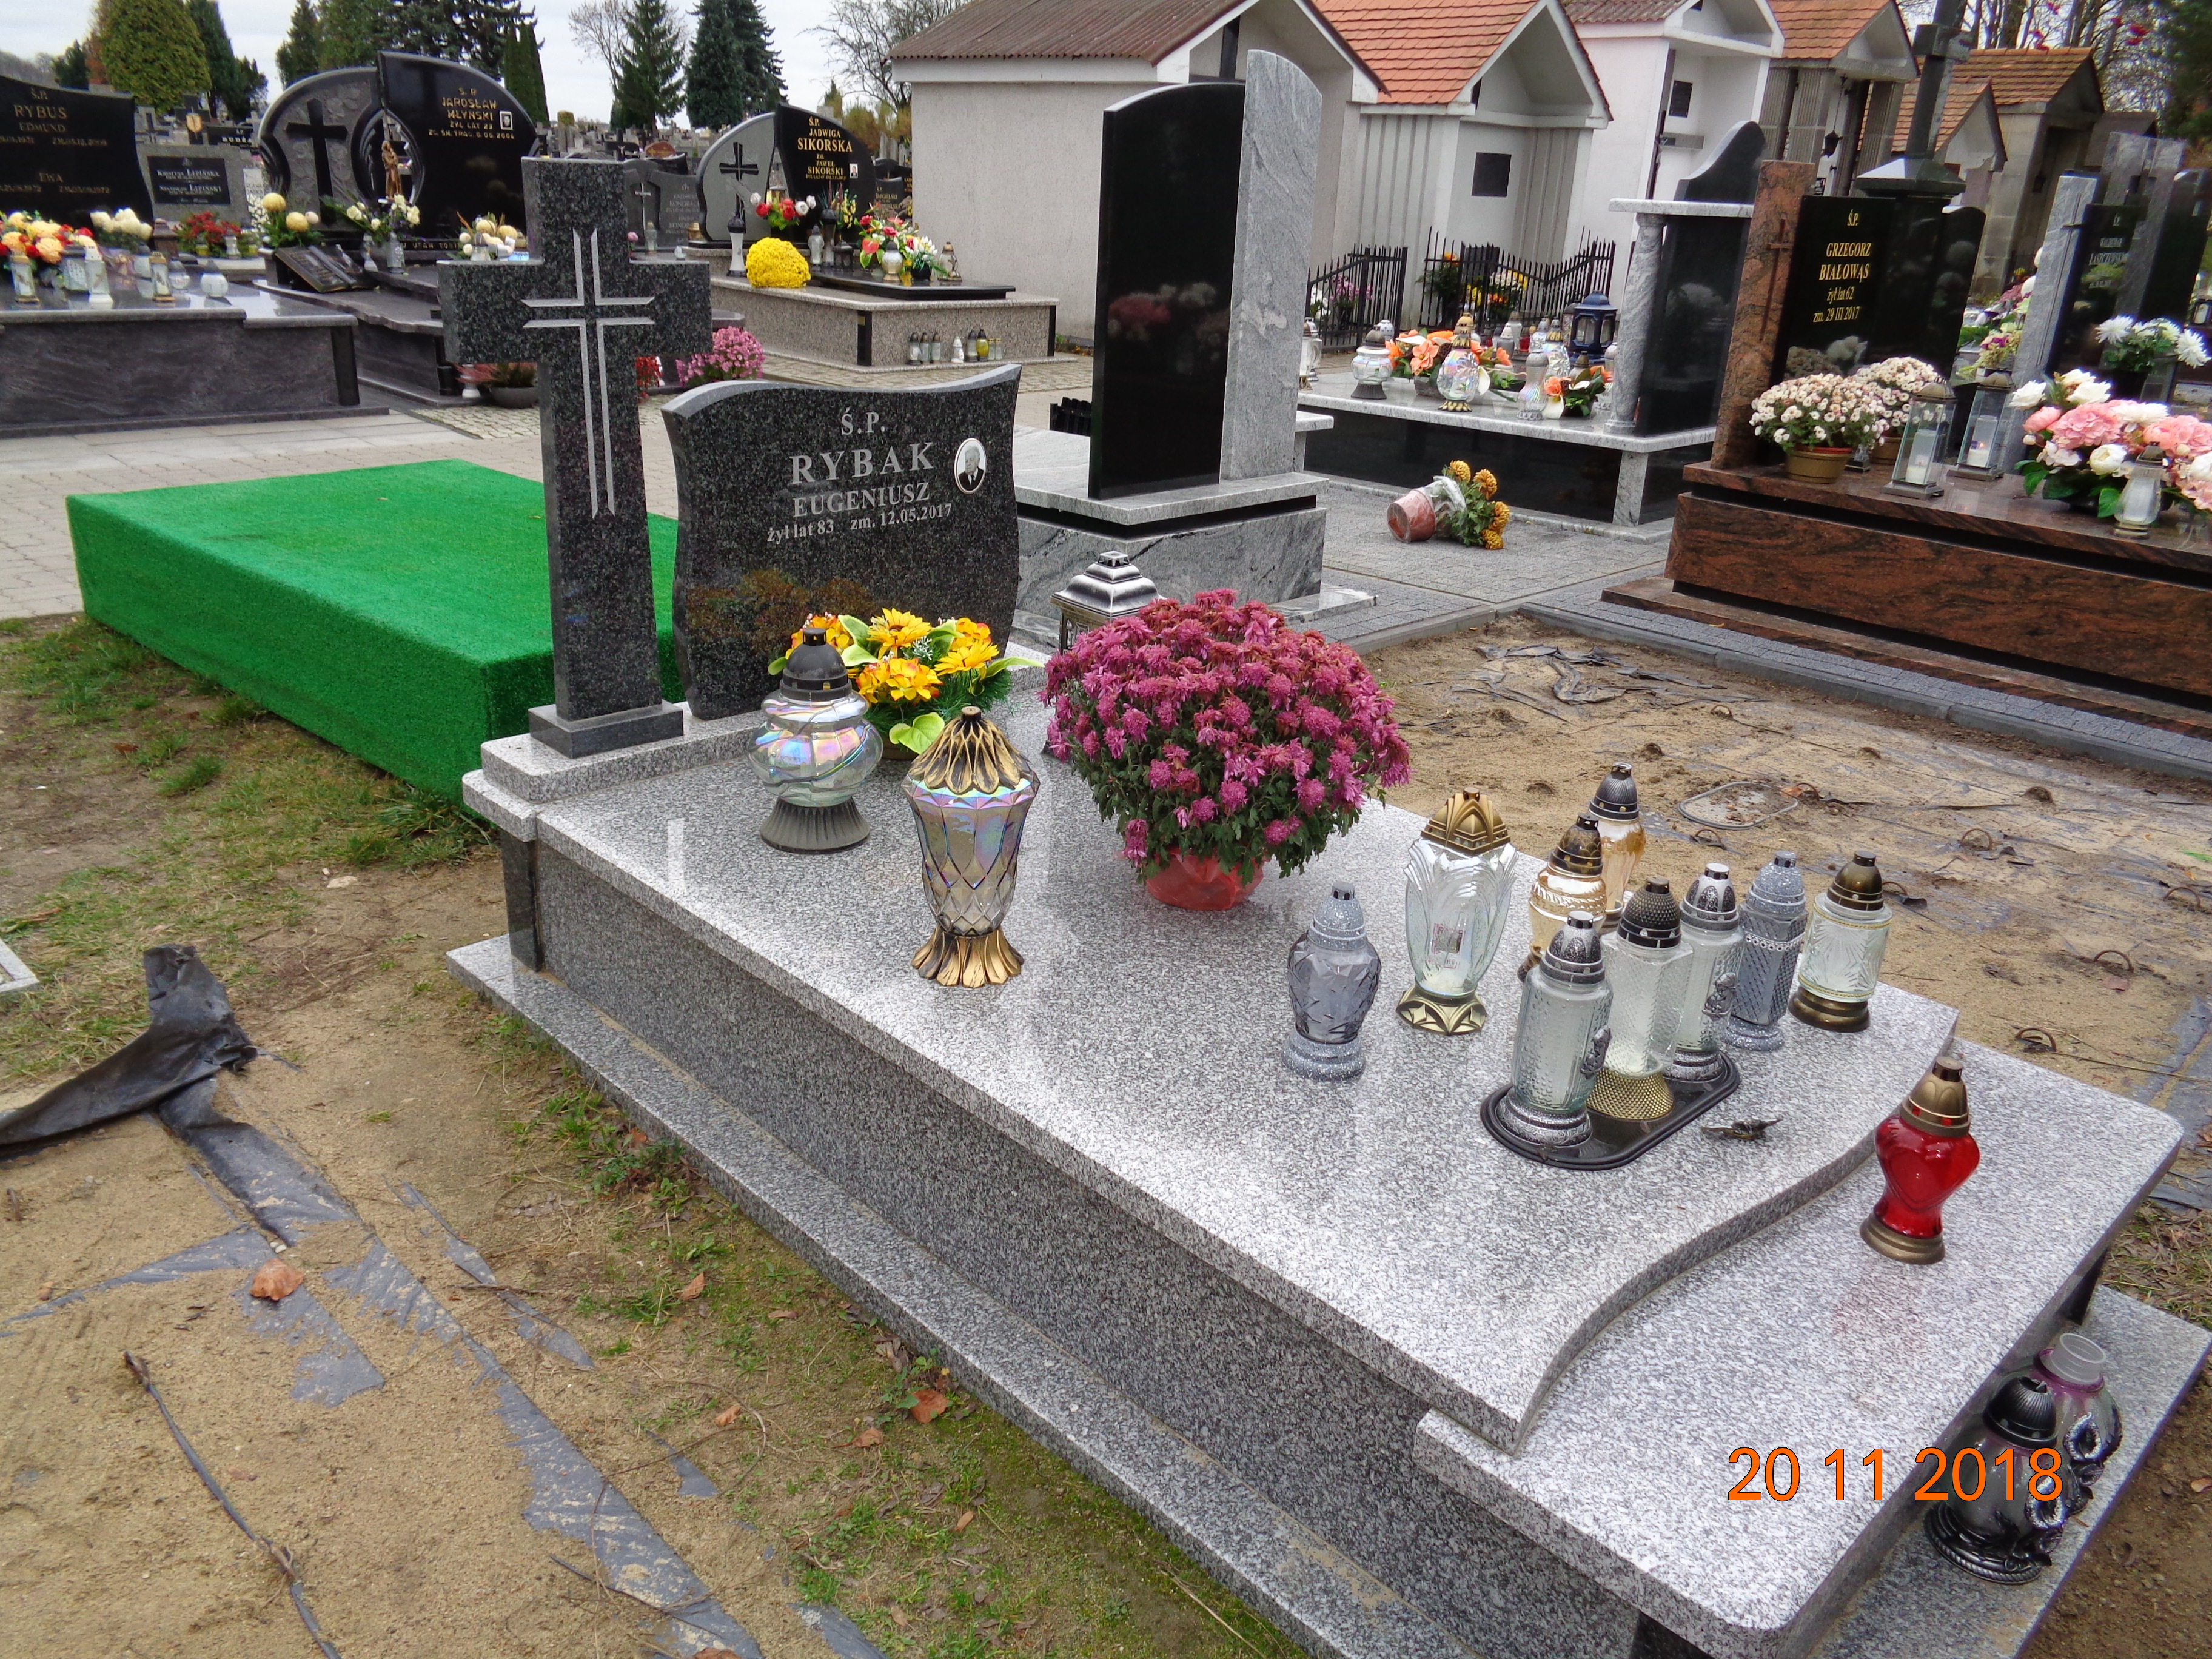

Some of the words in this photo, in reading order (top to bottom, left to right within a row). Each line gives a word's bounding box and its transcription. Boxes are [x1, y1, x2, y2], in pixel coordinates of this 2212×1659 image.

[13, 104, 69, 119] RYBUS
[19, 122, 67, 133] EDMUND
[809, 128, 841, 138] JADWIGA
[797, 137, 853, 153] SIKORSKA
[39, 172, 64, 183] EWA
[808, 166, 843, 176] SIKORSKI
[1847, 209, 1859, 226] Ś.P.
[1826, 242, 1872, 258] GRZEGORZ
[1819, 263, 1870, 283] BIAŁOWĄS
[1826, 287, 1838, 304] żył
[1837, 286, 1846, 301] lat
[1846, 286, 1855, 300] 62
[1813, 312, 1824, 323] zm.
[1825, 307, 1835, 322] 29
[1835, 307, 1845, 321] III
[1844, 306, 1860, 320] 2017
[789, 442, 934, 486] RYBAK
[793, 481, 930, 517] EUGENIUSZ
[793, 524, 813, 538] lat
[817, 518, 834, 535] 83
[850, 515, 876, 531] zm.
[880, 503, 952, 526] 12.05.2017
